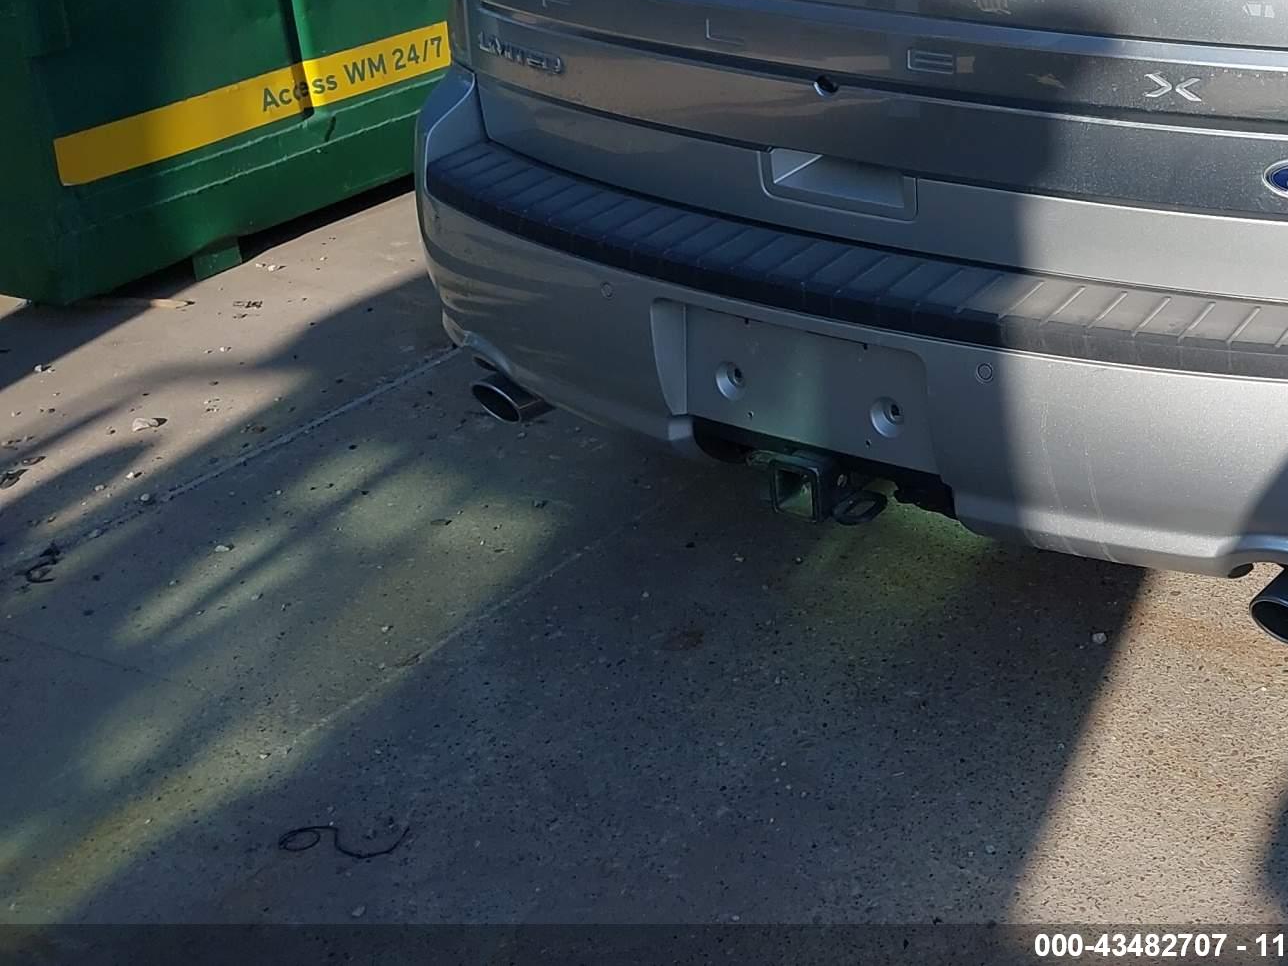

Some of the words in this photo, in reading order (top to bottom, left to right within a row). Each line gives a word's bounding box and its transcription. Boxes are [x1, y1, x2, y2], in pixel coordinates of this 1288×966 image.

[262, 75, 338, 112] Access
[343, 53, 388, 85] WM
[391, 36, 443, 72] 24/7
